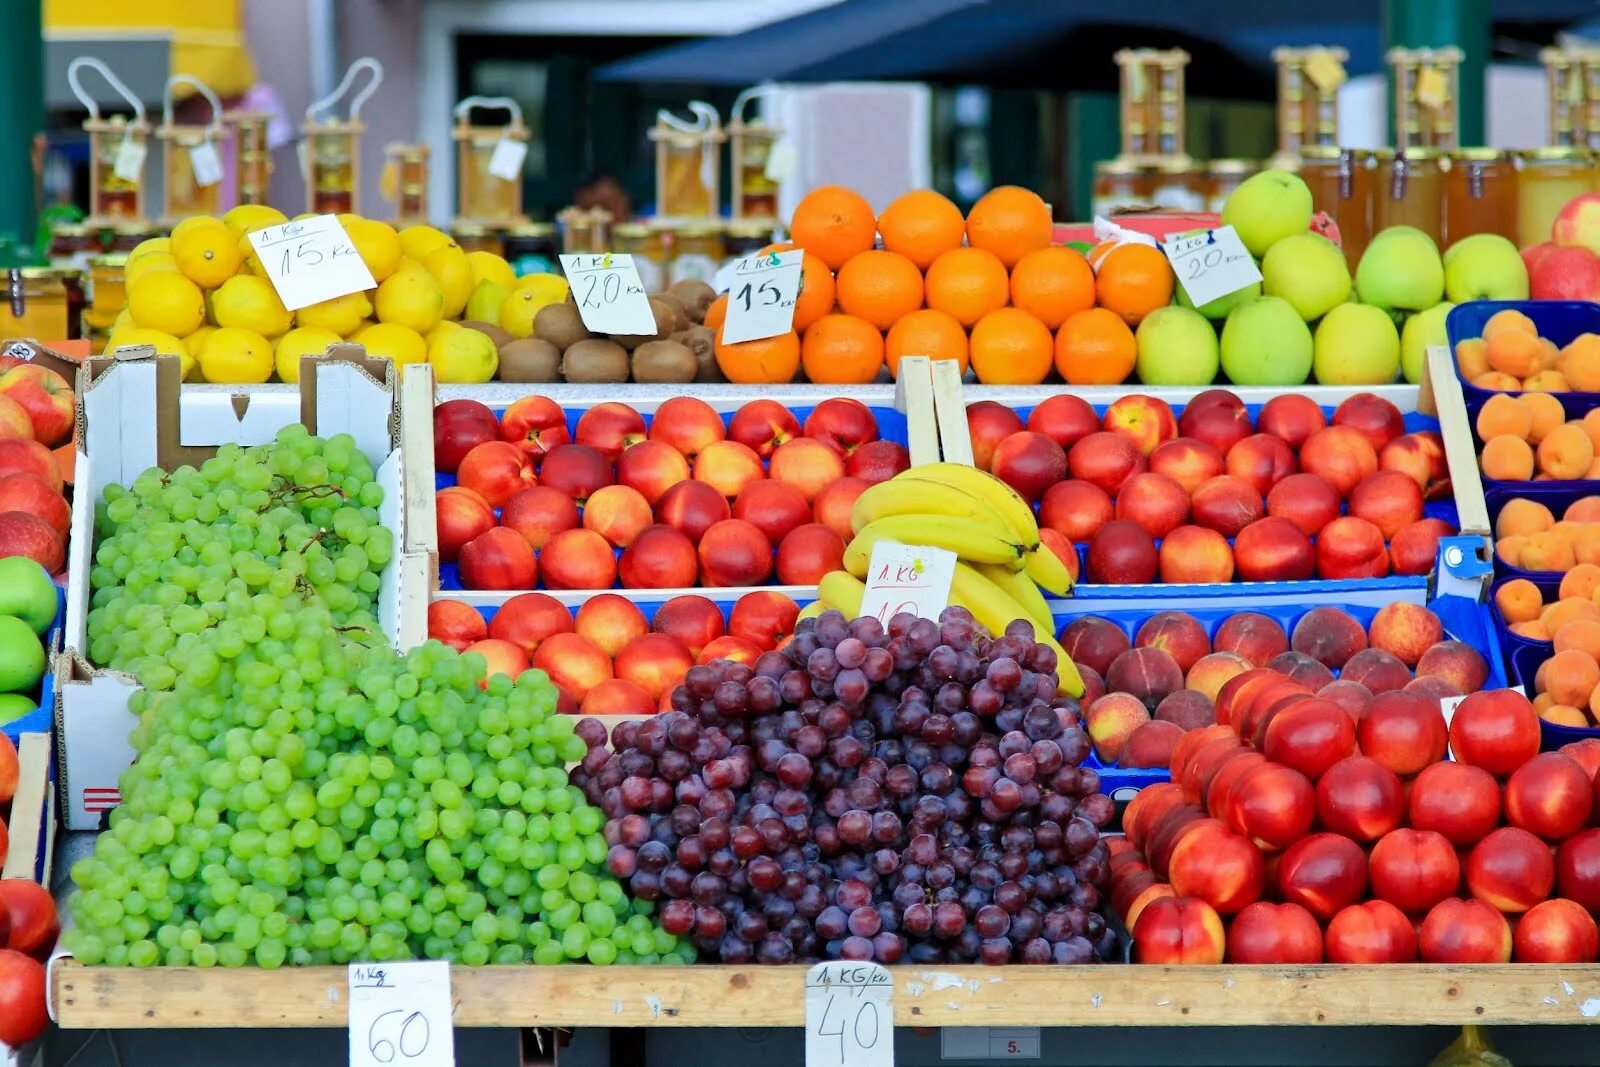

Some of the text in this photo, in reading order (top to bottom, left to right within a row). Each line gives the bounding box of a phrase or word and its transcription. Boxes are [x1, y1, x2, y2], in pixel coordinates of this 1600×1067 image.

[281, 239, 324, 277] 15
[1188, 249, 1223, 281] 20
[583, 273, 621, 309] 20
[736, 279, 781, 312] 15
[368, 1009, 430, 1063] 60
[818, 993, 879, 1064] 40
[1007, 1040, 1021, 1054] 5.
